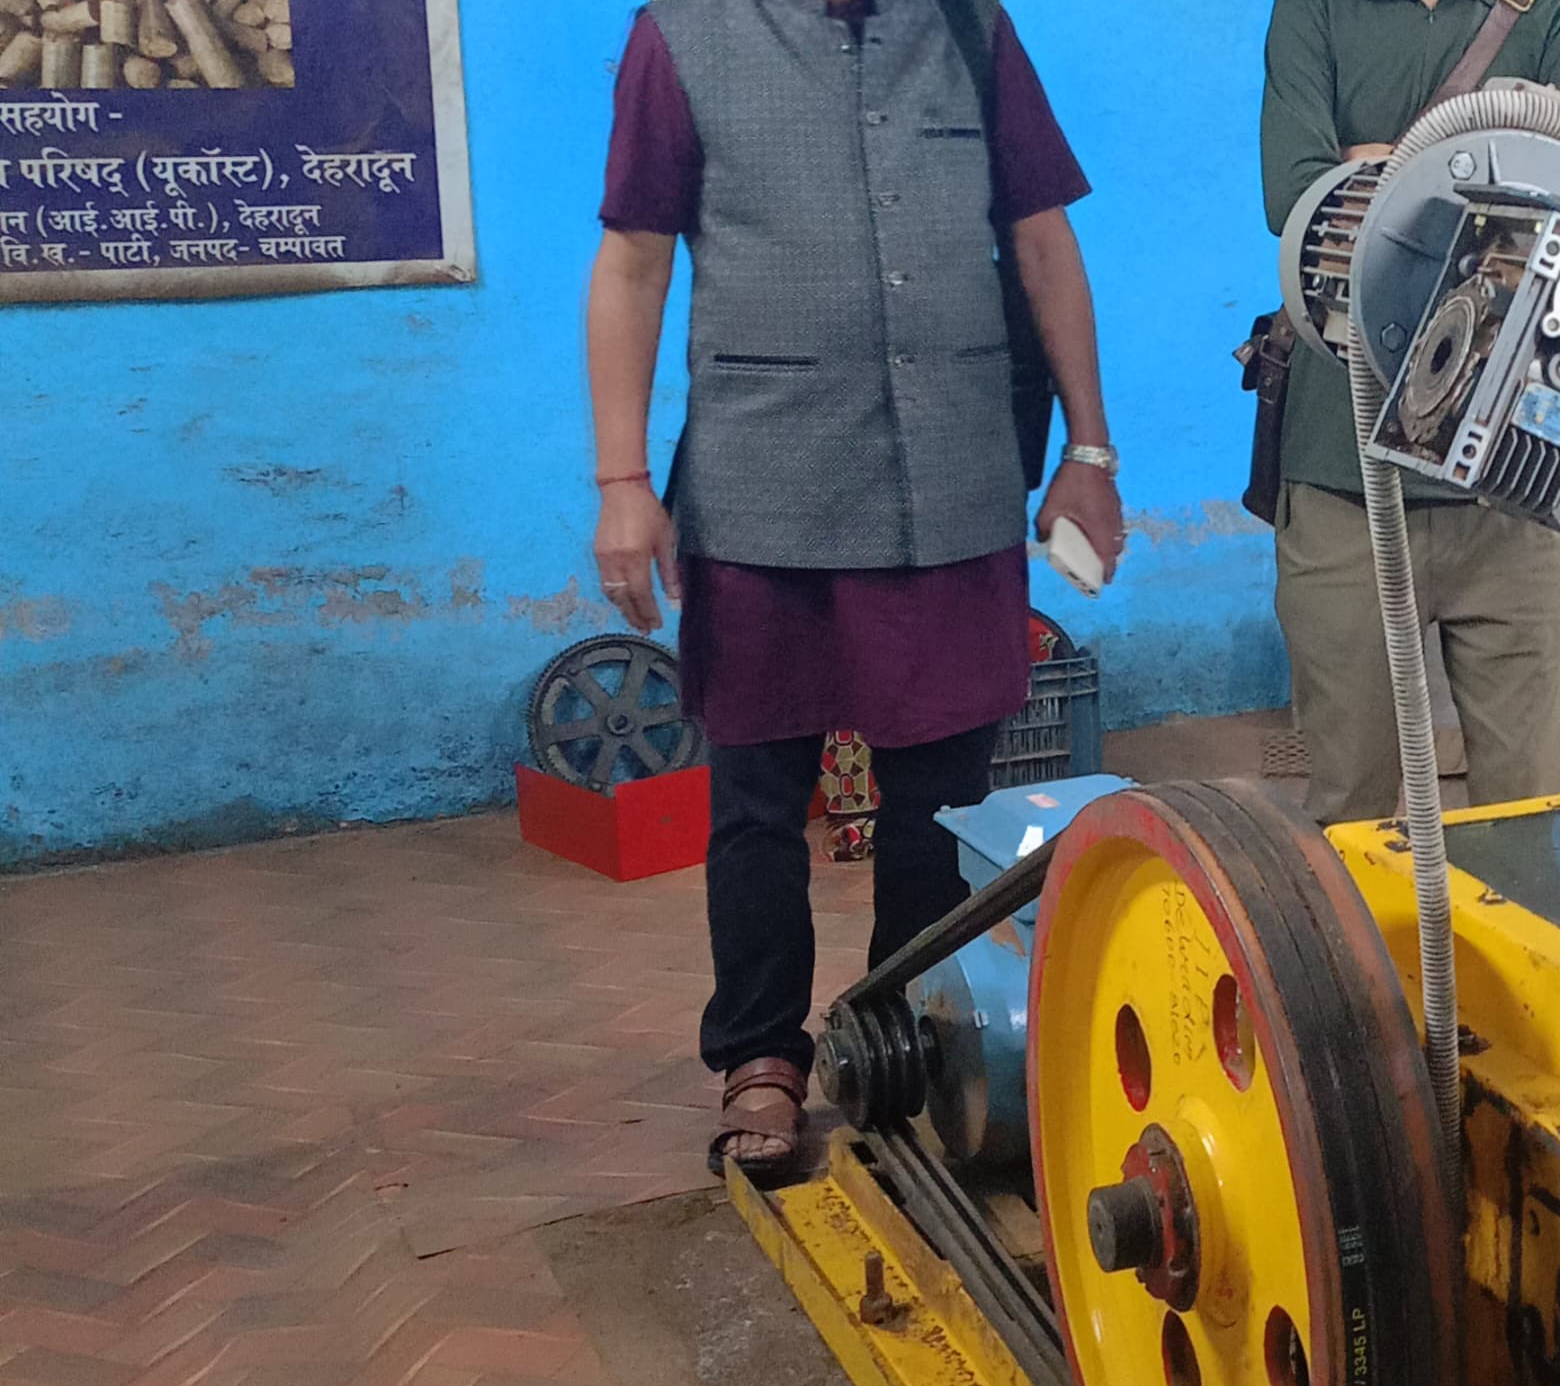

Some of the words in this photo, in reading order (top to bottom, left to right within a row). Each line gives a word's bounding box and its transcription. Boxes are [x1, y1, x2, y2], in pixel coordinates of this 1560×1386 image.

[0, 91, 100, 136] सहयोग
[19, 146, 129, 197] परिषद्
[295, 144, 416, 193] देहरादून
[234, 199, 321, 234] देहरादून
[258, 236, 346, 259] चम्पावत
[1352, 1308, 1367, 1332] LP
[1353, 1335, 1368, 1376] 3345
